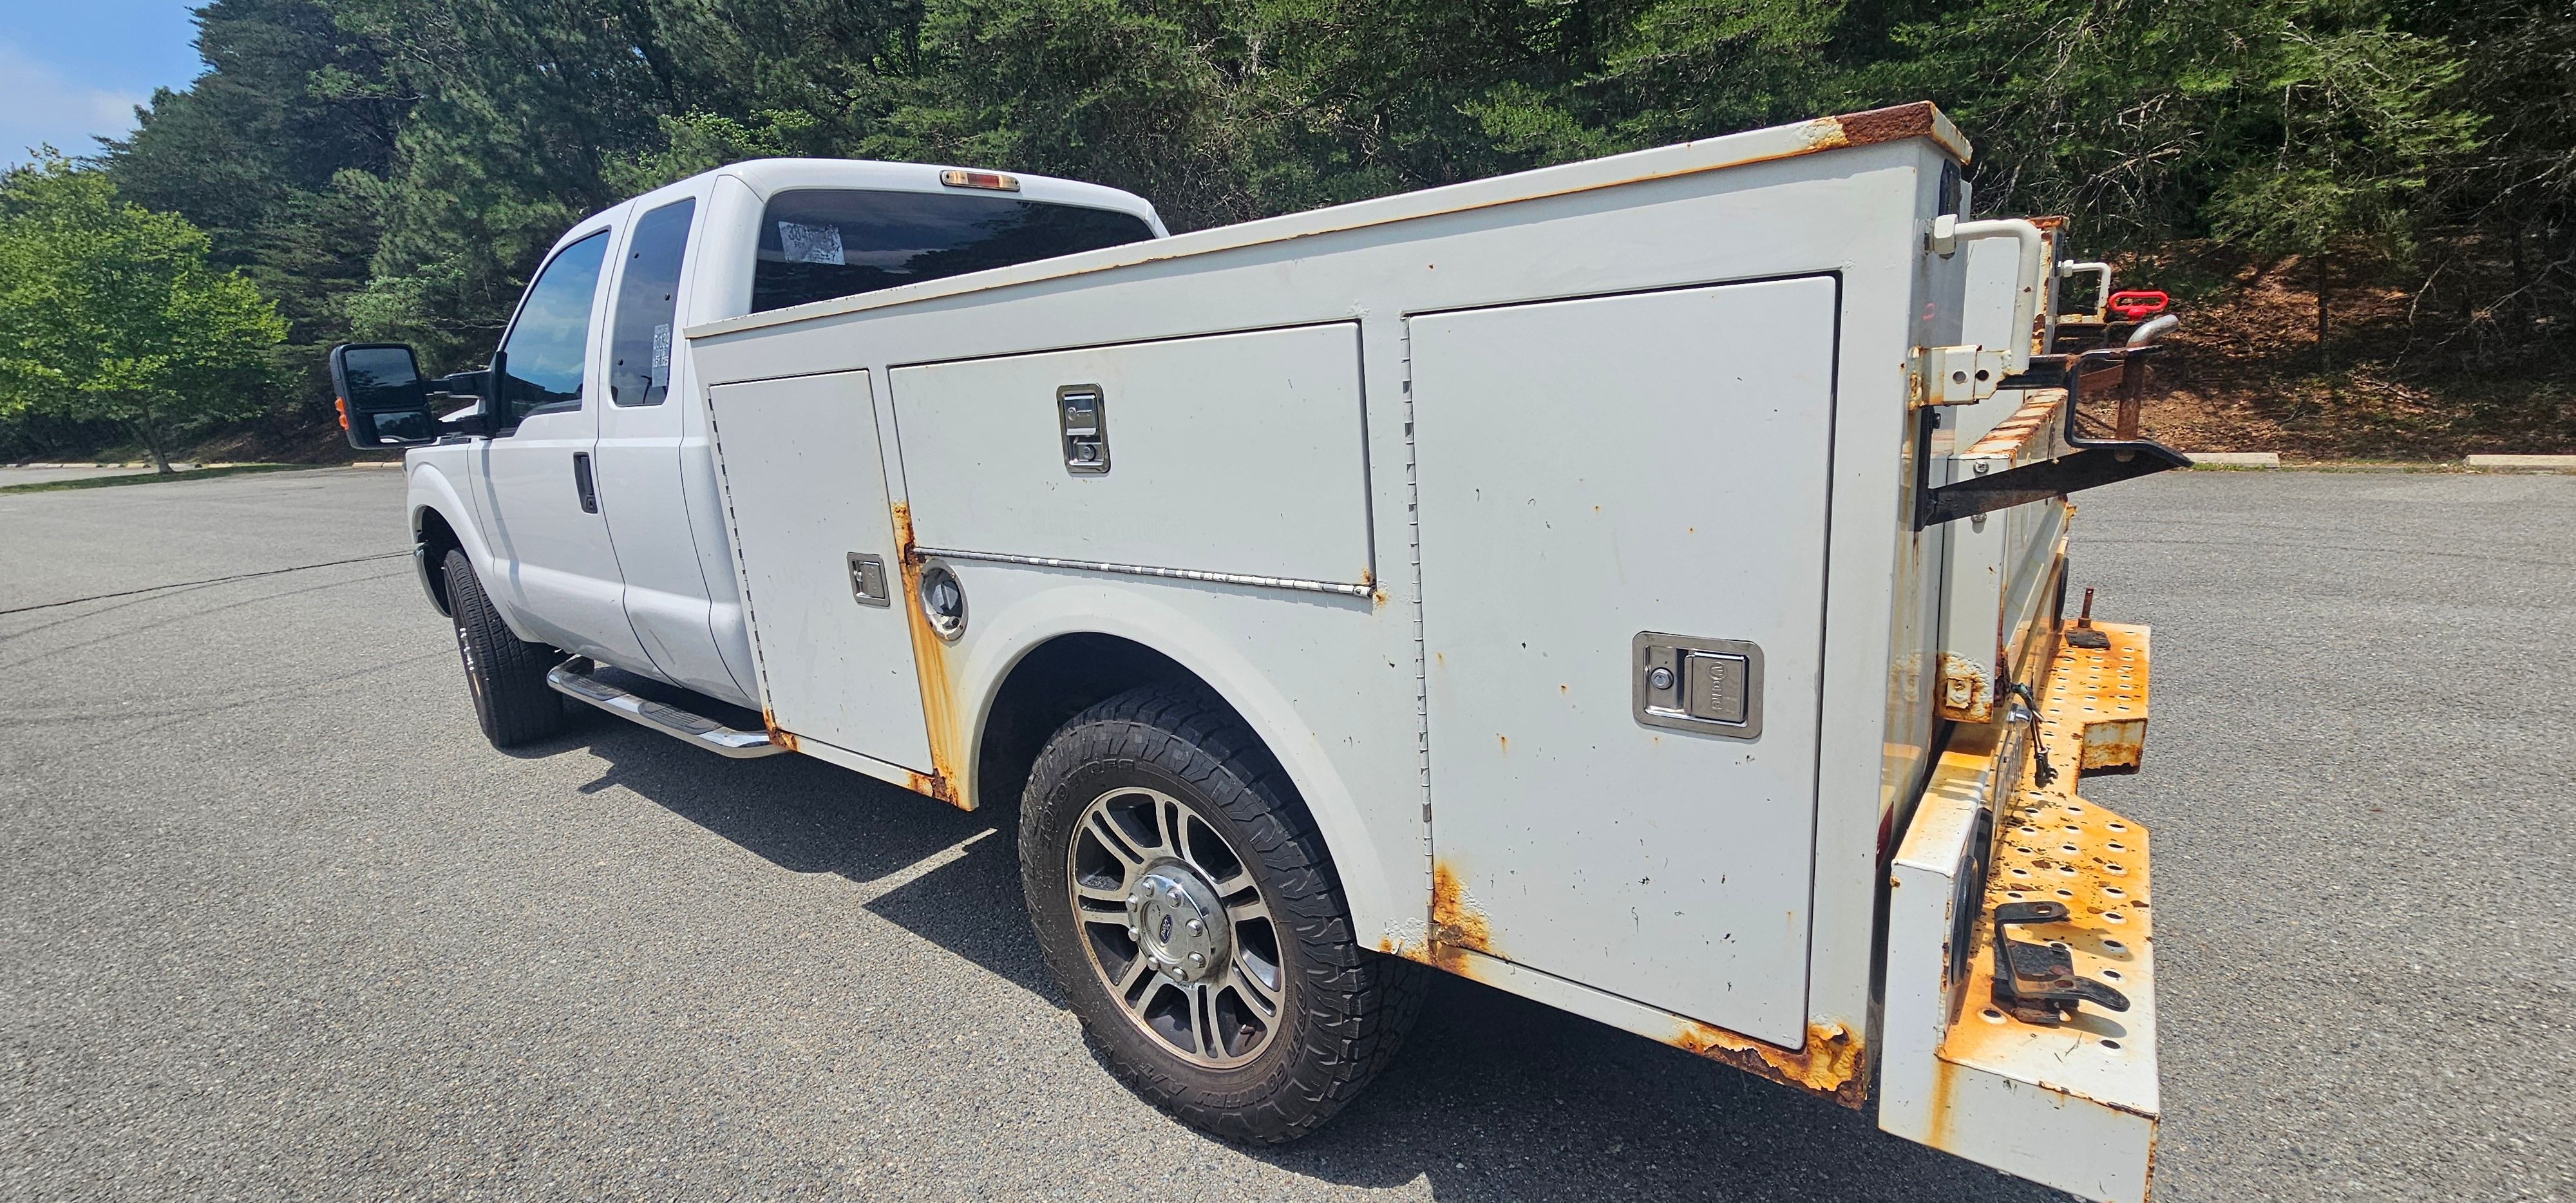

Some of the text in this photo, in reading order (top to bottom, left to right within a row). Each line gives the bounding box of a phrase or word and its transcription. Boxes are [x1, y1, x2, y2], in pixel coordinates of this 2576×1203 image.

[1160, 918, 1171, 941] Ford
[1139, 981, 1307, 1109] OPEN COUNTRY A/T
